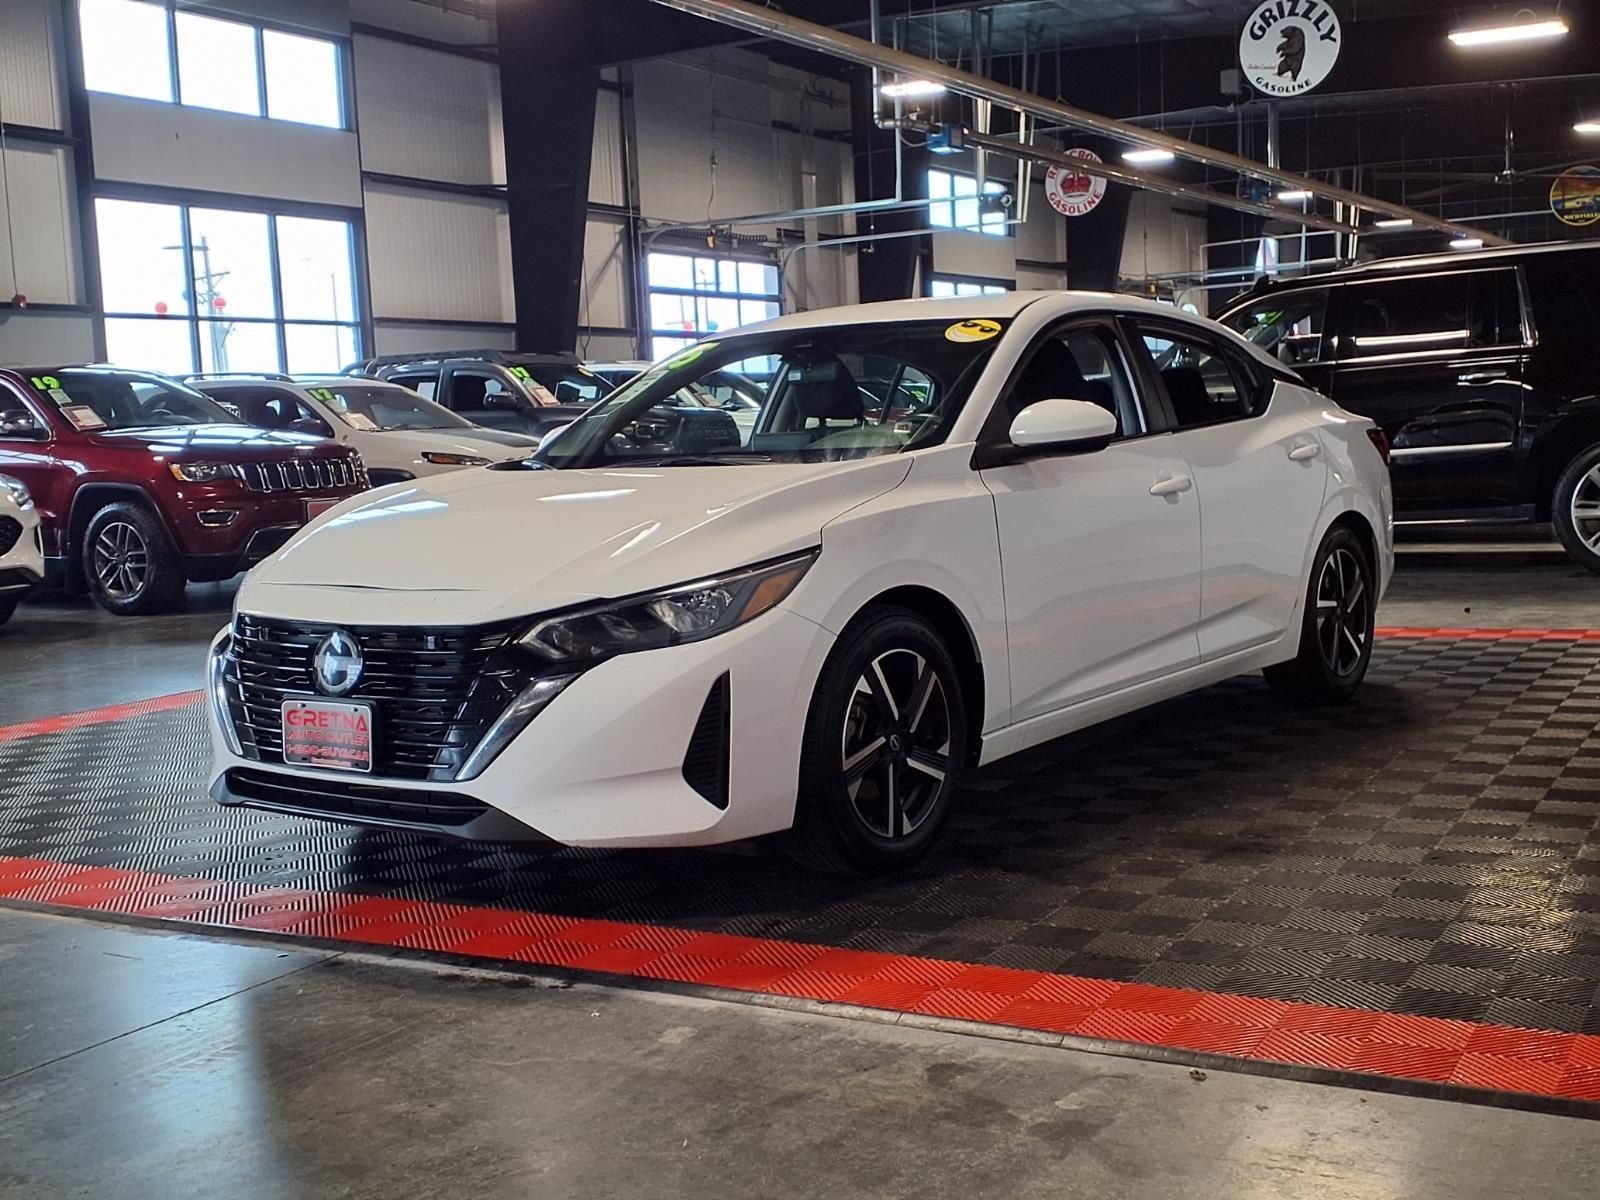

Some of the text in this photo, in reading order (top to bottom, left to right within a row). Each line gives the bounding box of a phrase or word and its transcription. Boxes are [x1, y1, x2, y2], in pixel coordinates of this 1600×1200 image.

[1249, 0, 1337, 43] GRIZZLY
[1255, 76, 1312, 93] GASOLINE
[1049, 191, 1102, 214] GASOLINE
[509, 367, 530, 378] 17
[31, 376, 60, 390] 19
[309, 389, 332, 400] 17
[286, 709, 368, 731] GRETNA
[287, 730, 324, 743] AUTO
